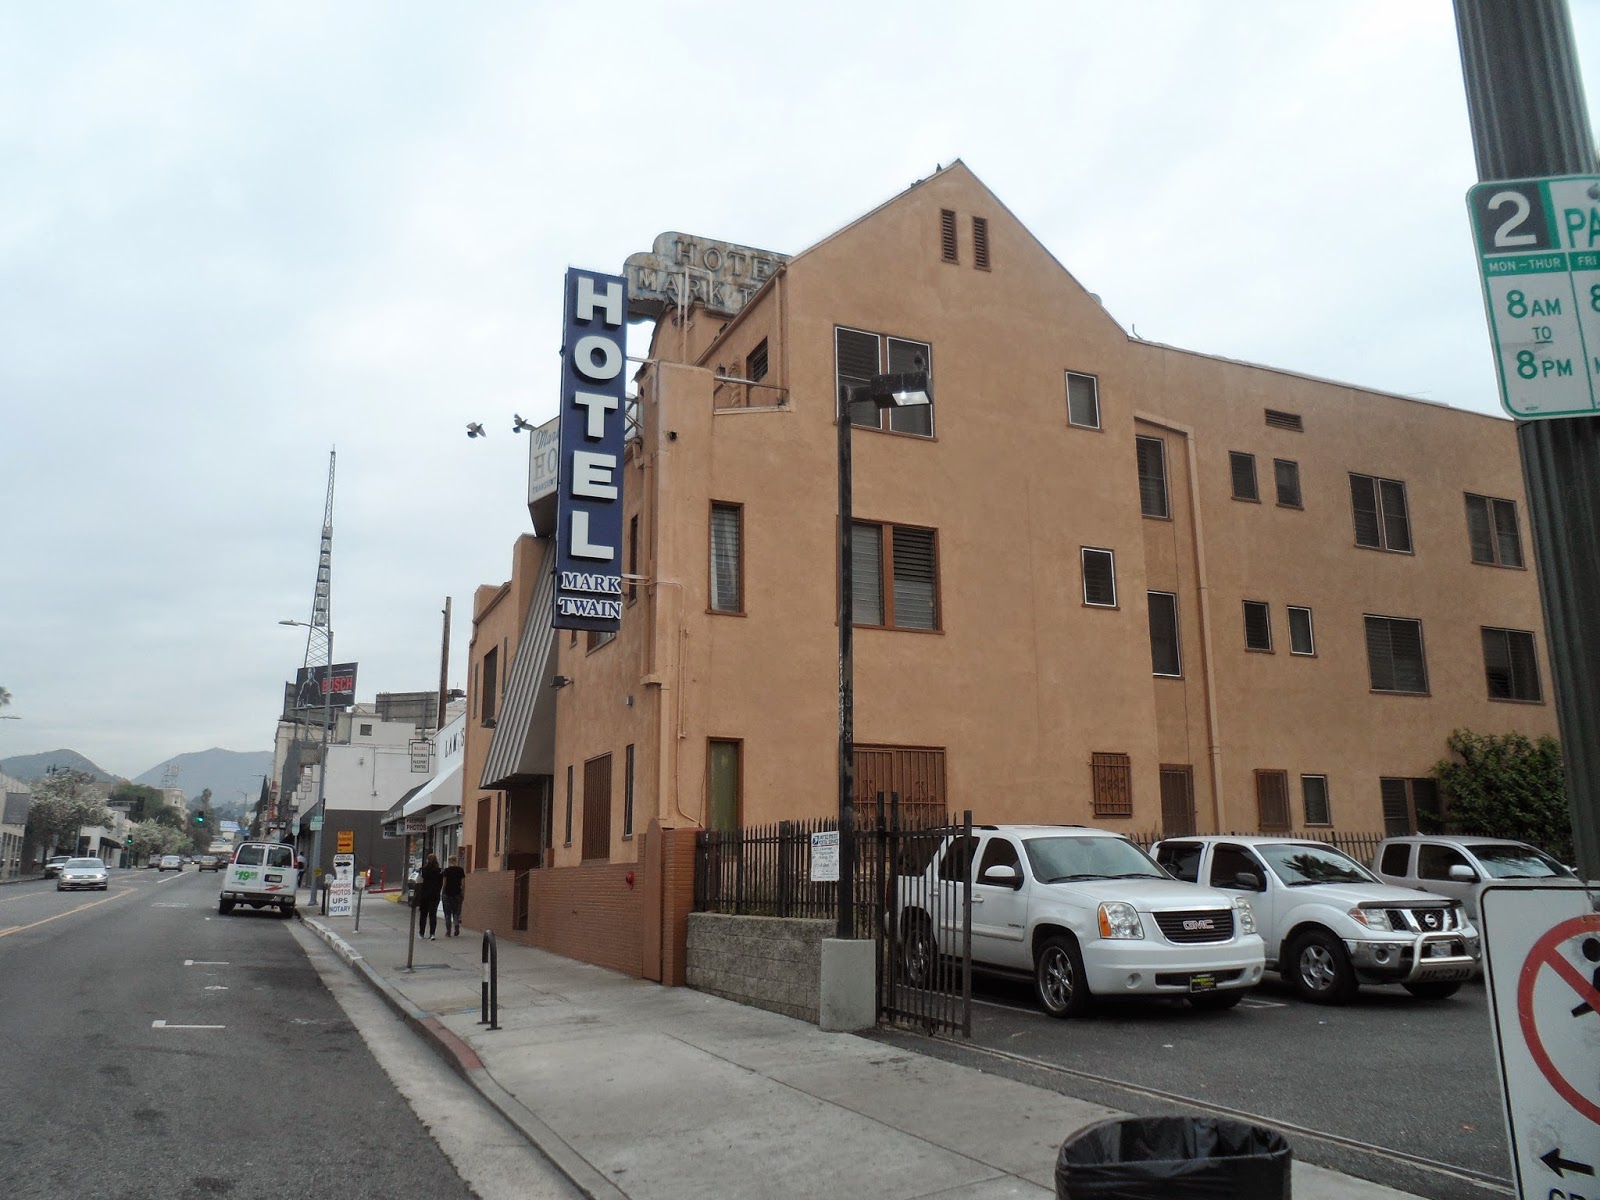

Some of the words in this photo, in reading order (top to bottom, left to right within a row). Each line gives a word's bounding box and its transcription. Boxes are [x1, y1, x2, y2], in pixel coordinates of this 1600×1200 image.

[1487, 190, 1538, 248] 2
[674, 239, 772, 281] HOTE
[1577, 255, 1597, 267] FRI
[637, 267, 725, 306] MARK
[1532, 325, 1552, 342] TO
[570, 275, 623, 560] HOTEL
[560, 572, 622, 594] MARK
[558, 597, 622, 620] TWAIN
[406, 823, 427, 831] PHOTOS
[330, 888, 352, 896] PHOTOS
[329, 905, 351, 913] NOTARY
[1182, 919, 1215, 931] GMC
